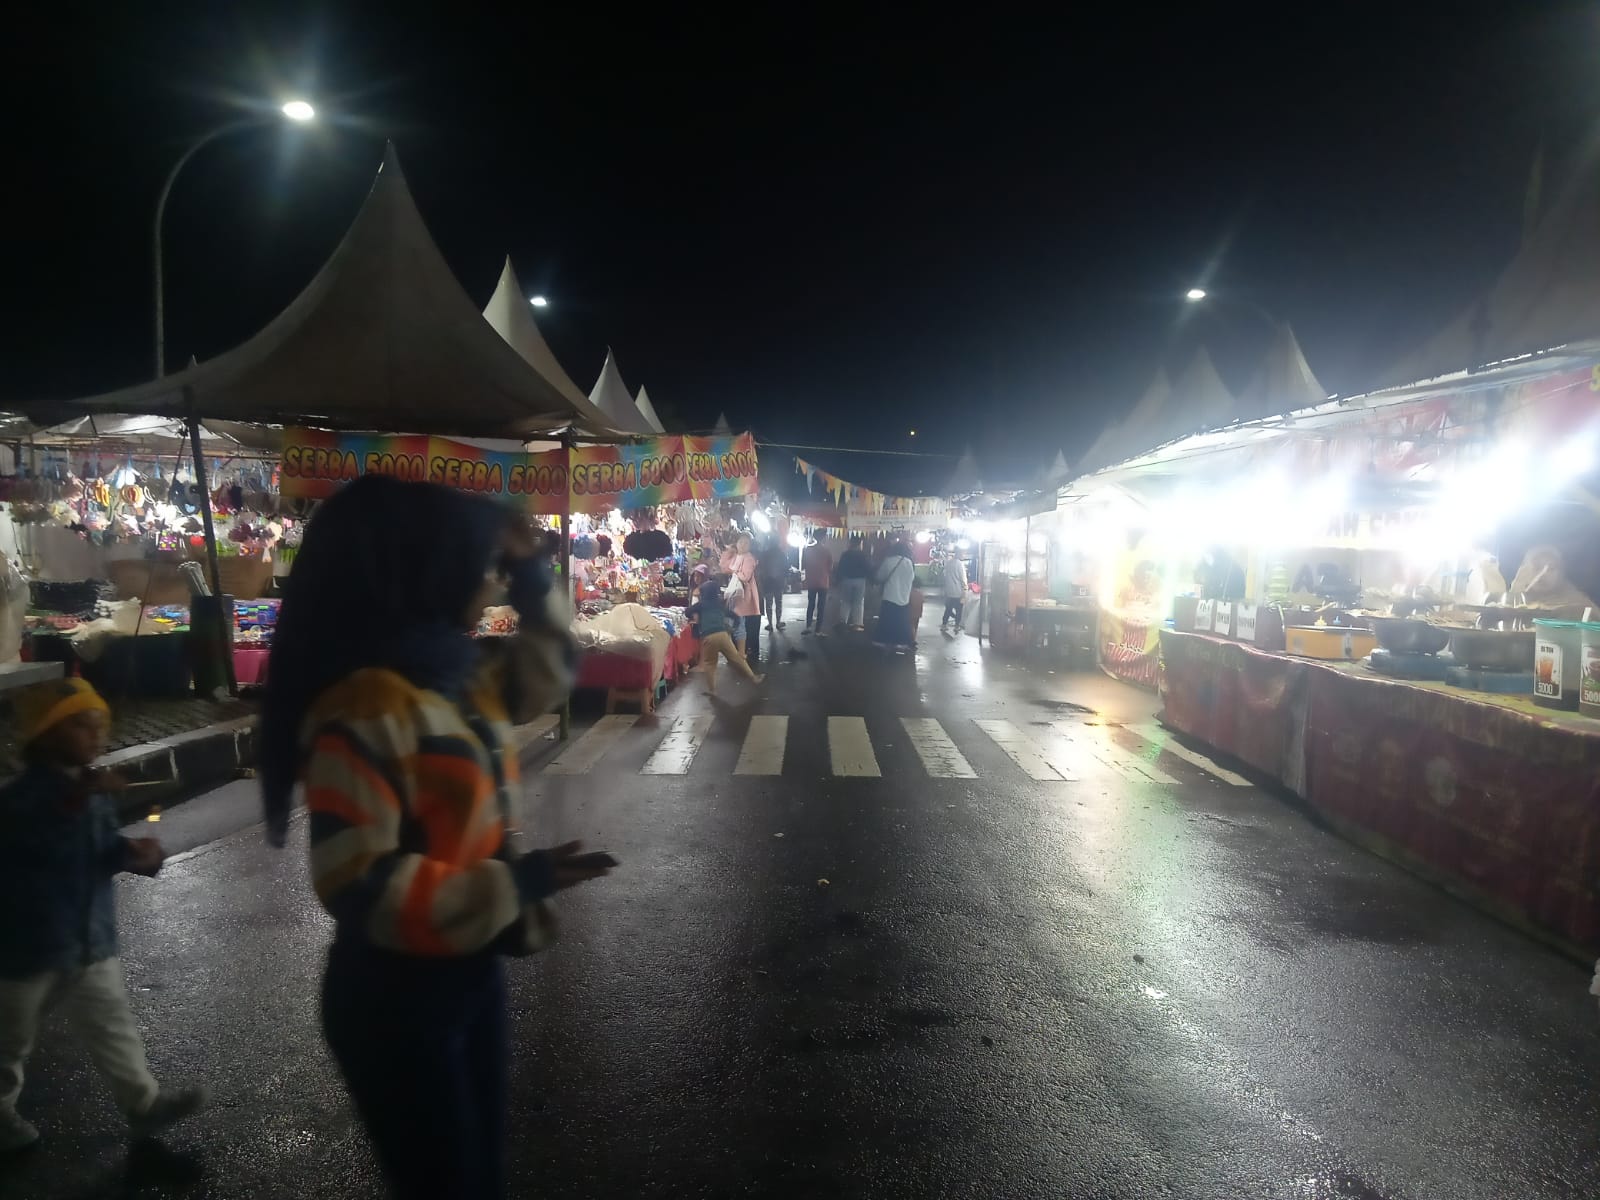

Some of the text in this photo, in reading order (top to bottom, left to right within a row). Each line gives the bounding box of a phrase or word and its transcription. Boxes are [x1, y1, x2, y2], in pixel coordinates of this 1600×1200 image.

[284, 446, 360, 482] SERBA
[364, 451, 425, 482] 5000
[429, 456, 503, 494] SERBA
[508, 464, 567, 495] 5000
[573, 463, 636, 495] SERBA
[639, 453, 685, 489] 5000
[1584, 690, 1600, 703] 500
